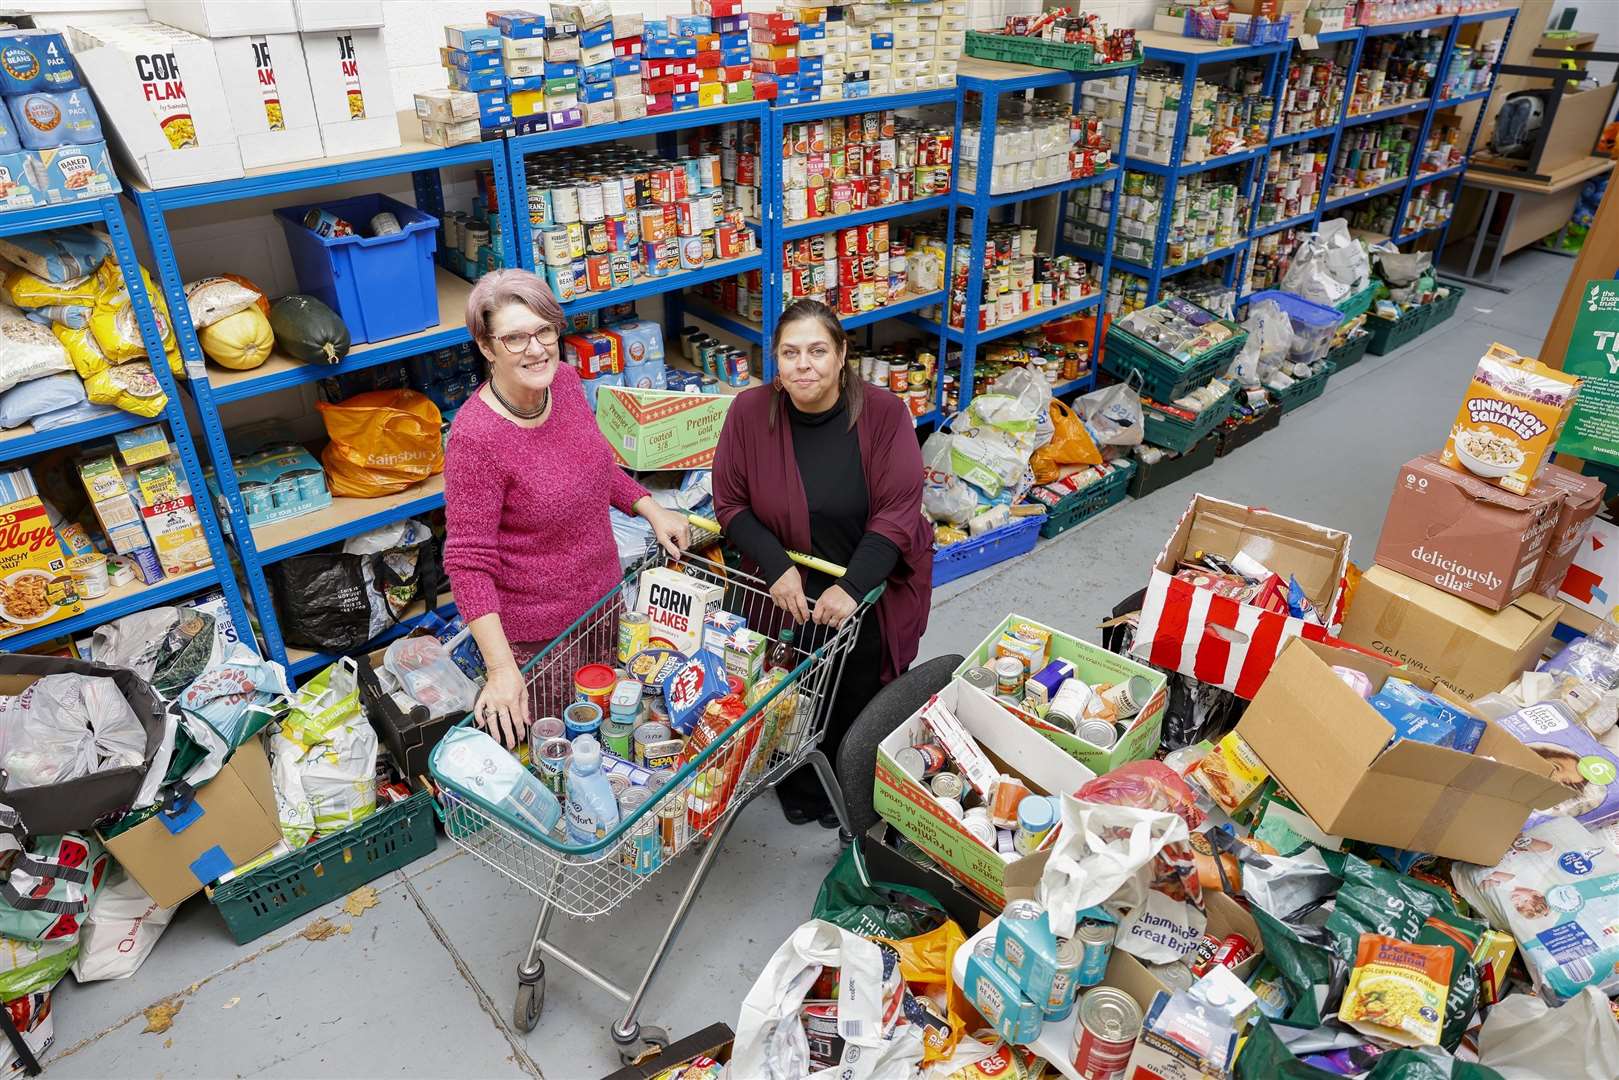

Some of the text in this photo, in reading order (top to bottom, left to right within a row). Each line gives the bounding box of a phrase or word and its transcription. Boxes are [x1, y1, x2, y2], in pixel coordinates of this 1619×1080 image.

[47, 41, 58, 58] 4
[7, 55, 31, 64] BEANS
[47, 57, 65, 66] PACK
[69, 92, 81, 107] 4
[68, 108, 87, 116] PACK
[60, 157, 87, 170] BAKED
[650, 336, 656, 346] 4
[470, 374, 477, 383] 6
[655, 371, 662, 381] 4
[686, 409, 722, 431] Premier
[1467, 398, 1547, 436] CINNAMON
[1471, 410, 1535, 440] SQUARES
[649, 430, 673, 445] Coated
[698, 425, 713, 436] Gold
[153, 499, 186, 515] £2.29
[1411, 546, 1503, 592] deliciously
[1434, 574, 1464, 593] ella
[649, 584, 692, 617] CORN
[648, 605, 689, 632] FLAKES
[1371, 640, 1431, 674] ORIGINAL
[880, 787, 916, 816] AA-Grade
[918, 821, 937, 837] Gold
[904, 821, 953, 858] Premier
[972, 864, 1004, 887] Coated
[860, 913, 887, 938] THIS
[1132, 925, 1166, 946] Great
[1378, 951, 1425, 968] Original
[979, 986, 1001, 1010] BEANZ
